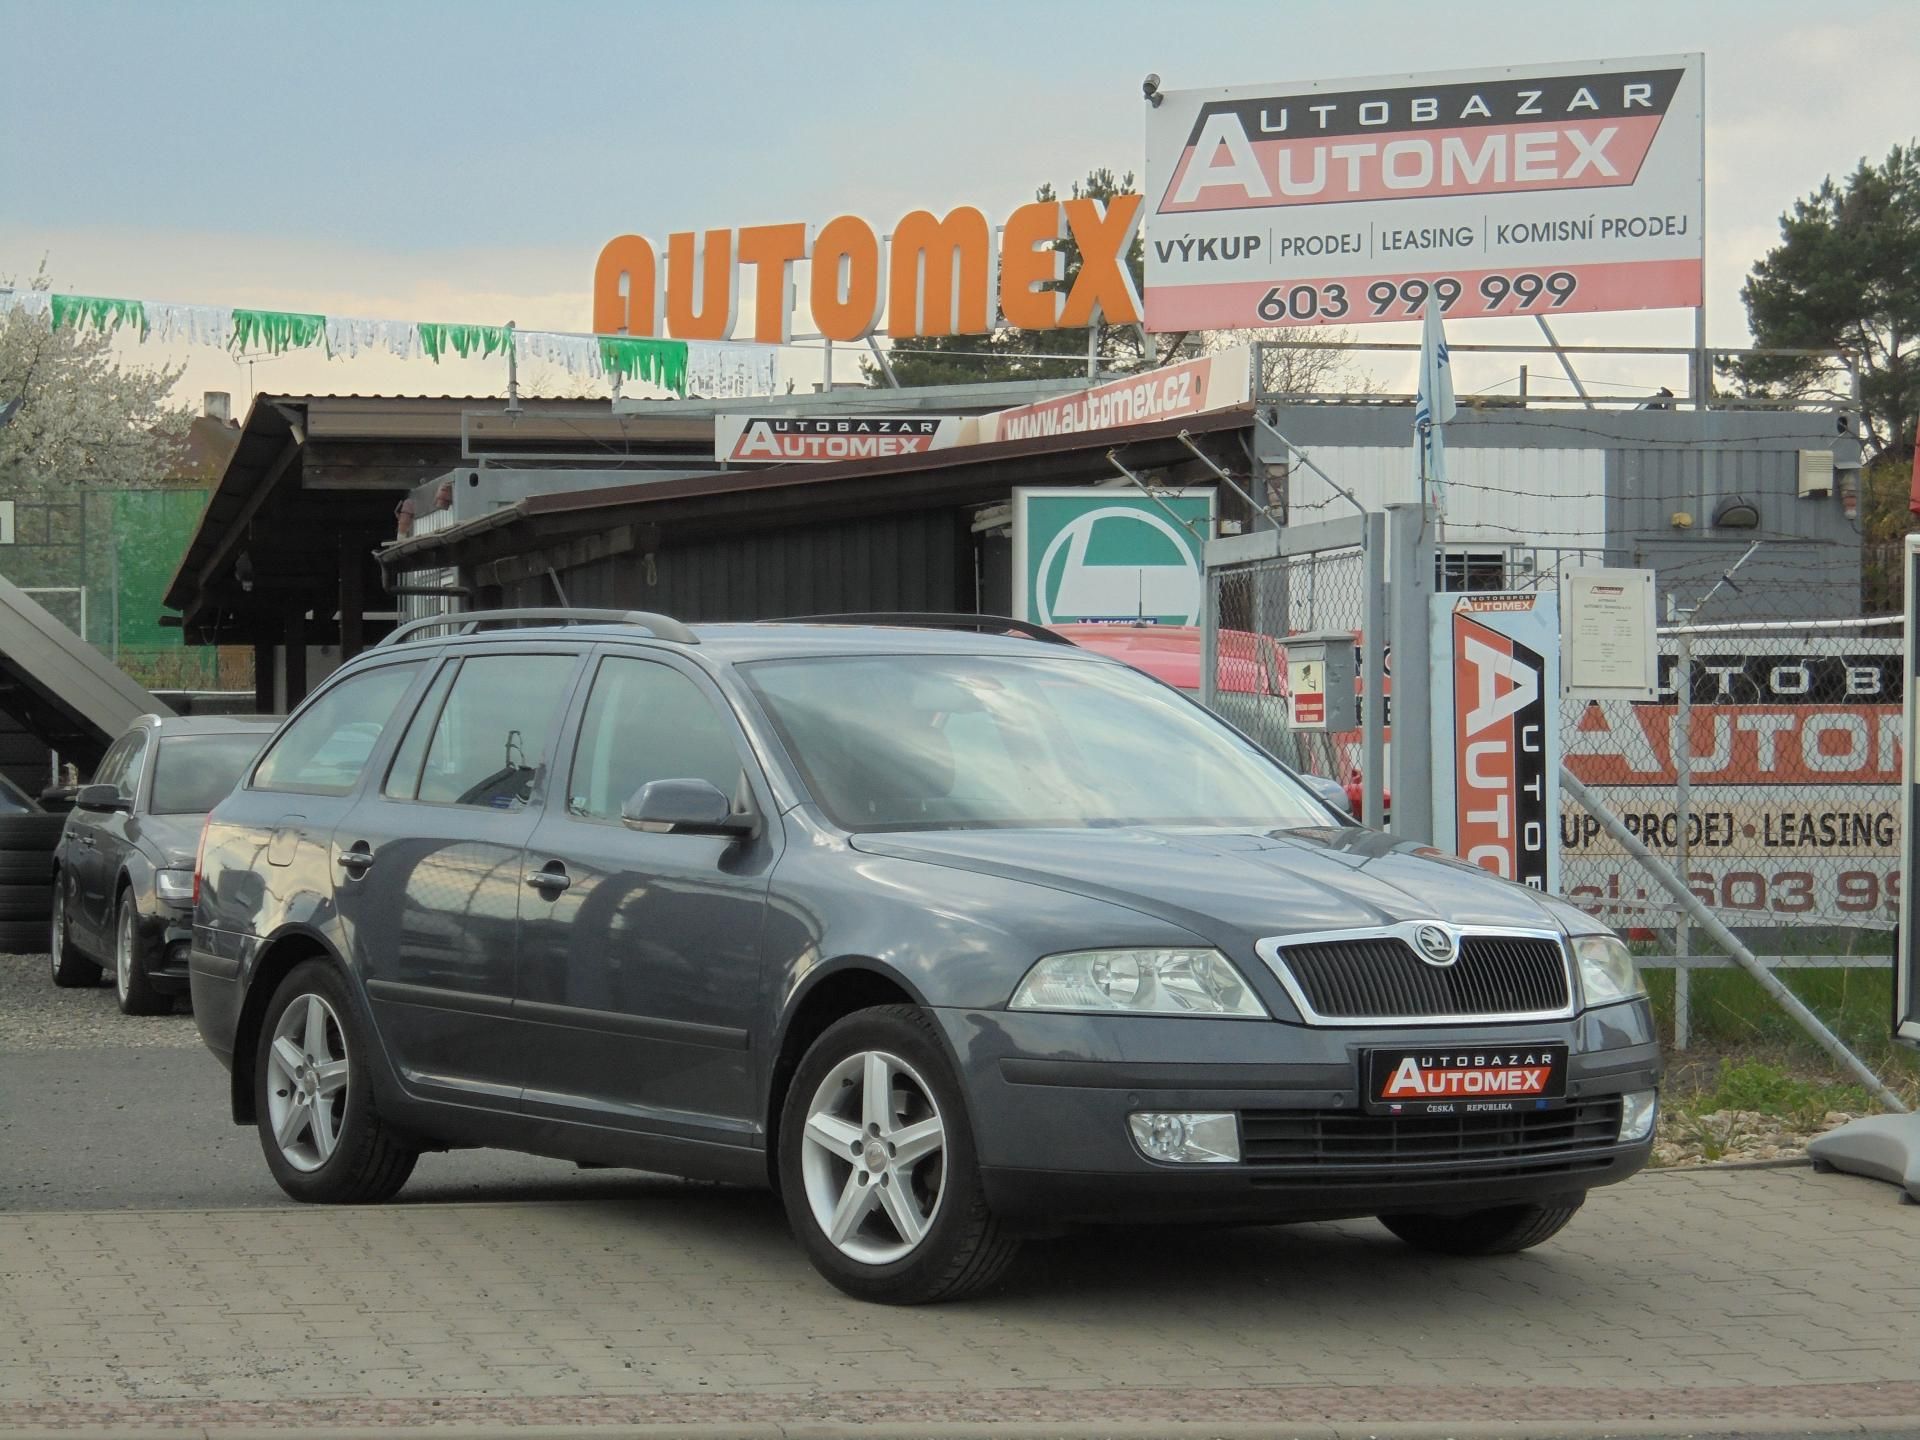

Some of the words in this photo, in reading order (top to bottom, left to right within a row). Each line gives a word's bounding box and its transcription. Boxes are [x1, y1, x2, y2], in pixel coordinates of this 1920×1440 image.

[1172, 112, 1620, 205] AUTOMEX
[1154, 233, 1262, 264] VÝKUP
[1280, 232, 1363, 258] PRODEJ
[1382, 226, 1475, 252] LEASING
[1496, 213, 1595, 246] KOMISNÍ
[1601, 214, 1689, 240] PRODEJ
[592, 193, 1145, 345] AUTOMEX
[1256, 283, 1350, 322] 603
[1366, 277, 1463, 316] 999
[1479, 271, 1578, 310] 999
[1006, 371, 1191, 441] www.automex.cz
[738, 421, 921, 456] AUTOMEX
[1455, 596, 1531, 612] AUTOMEX
[1763, 811, 1894, 848] LEASING
[1388, 1057, 1541, 1094] AUTOMEX
[1426, 1103, 1454, 1113] ČESKÁ
[1466, 1103, 1513, 1112] REPUBLIKA
